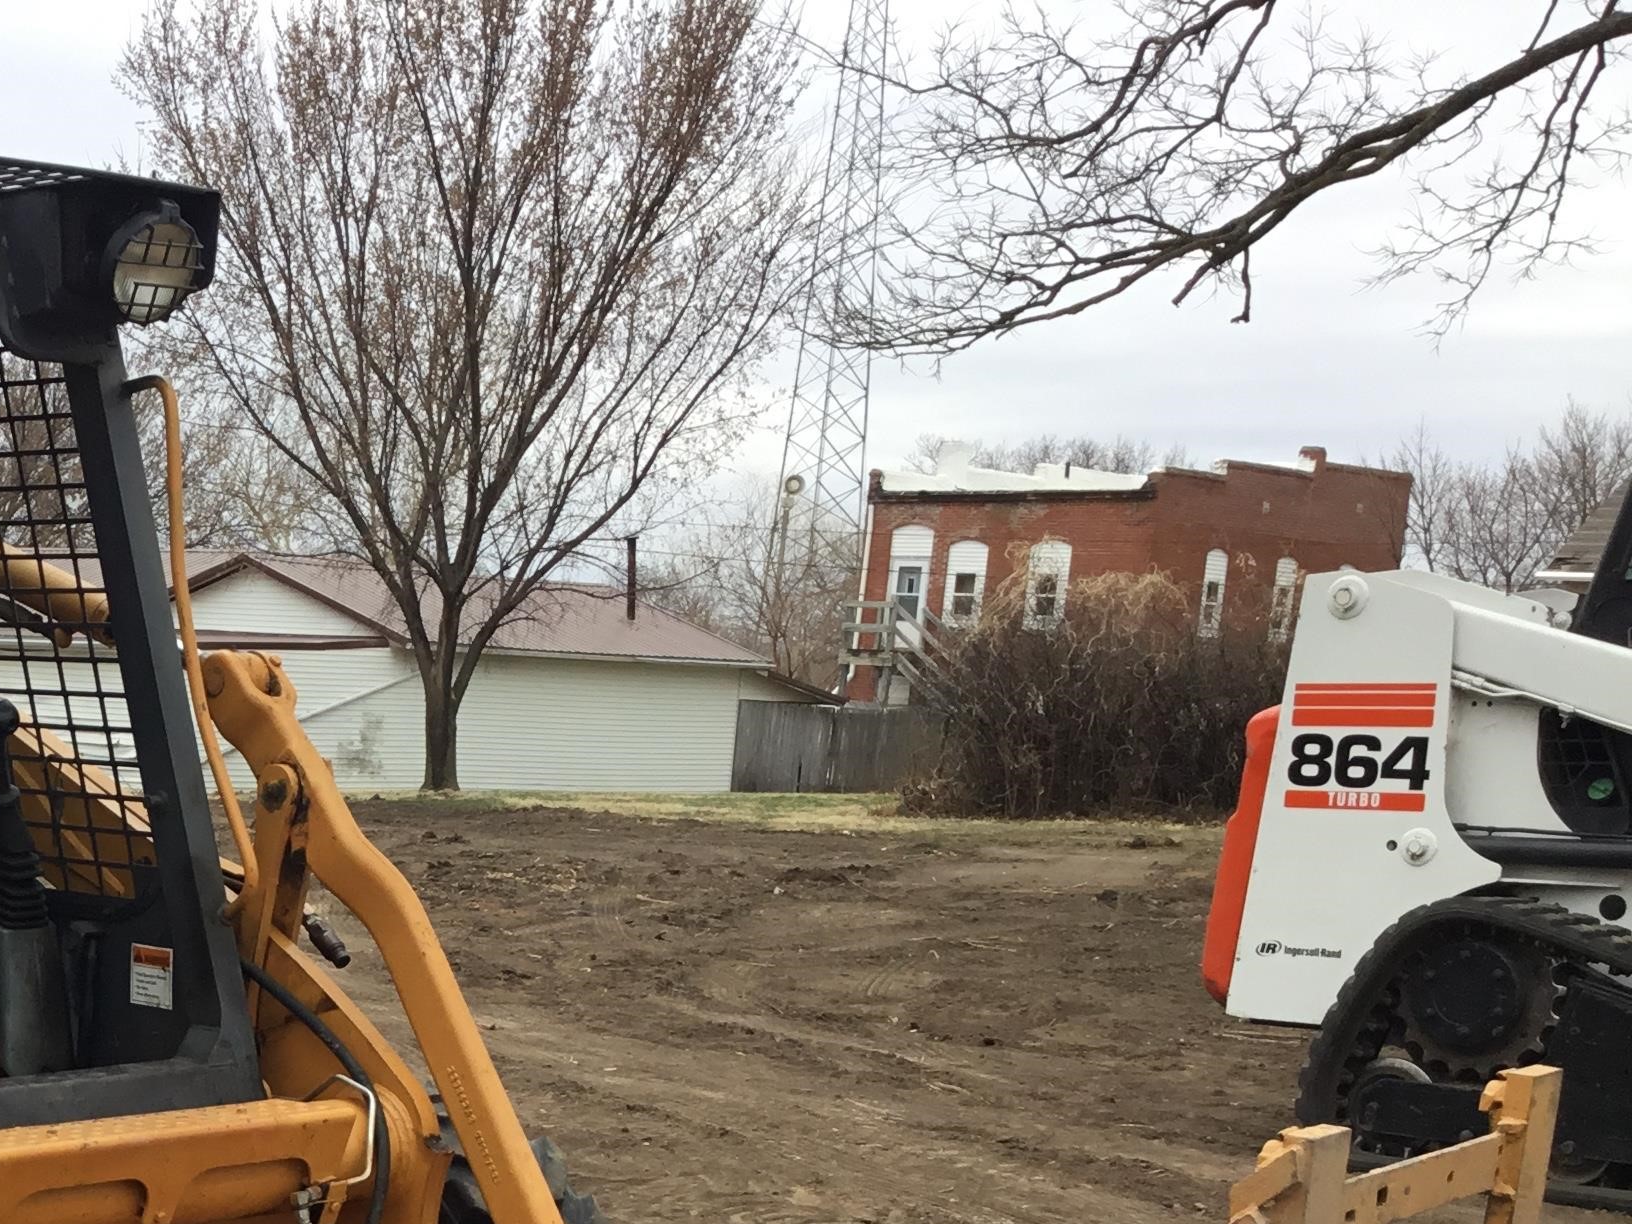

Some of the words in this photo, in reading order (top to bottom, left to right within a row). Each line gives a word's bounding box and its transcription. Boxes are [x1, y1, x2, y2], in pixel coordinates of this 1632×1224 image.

[1287, 733, 1431, 791] 864
[1326, 791, 1381, 807] TURBO
[1259, 942, 1278, 954] IR
